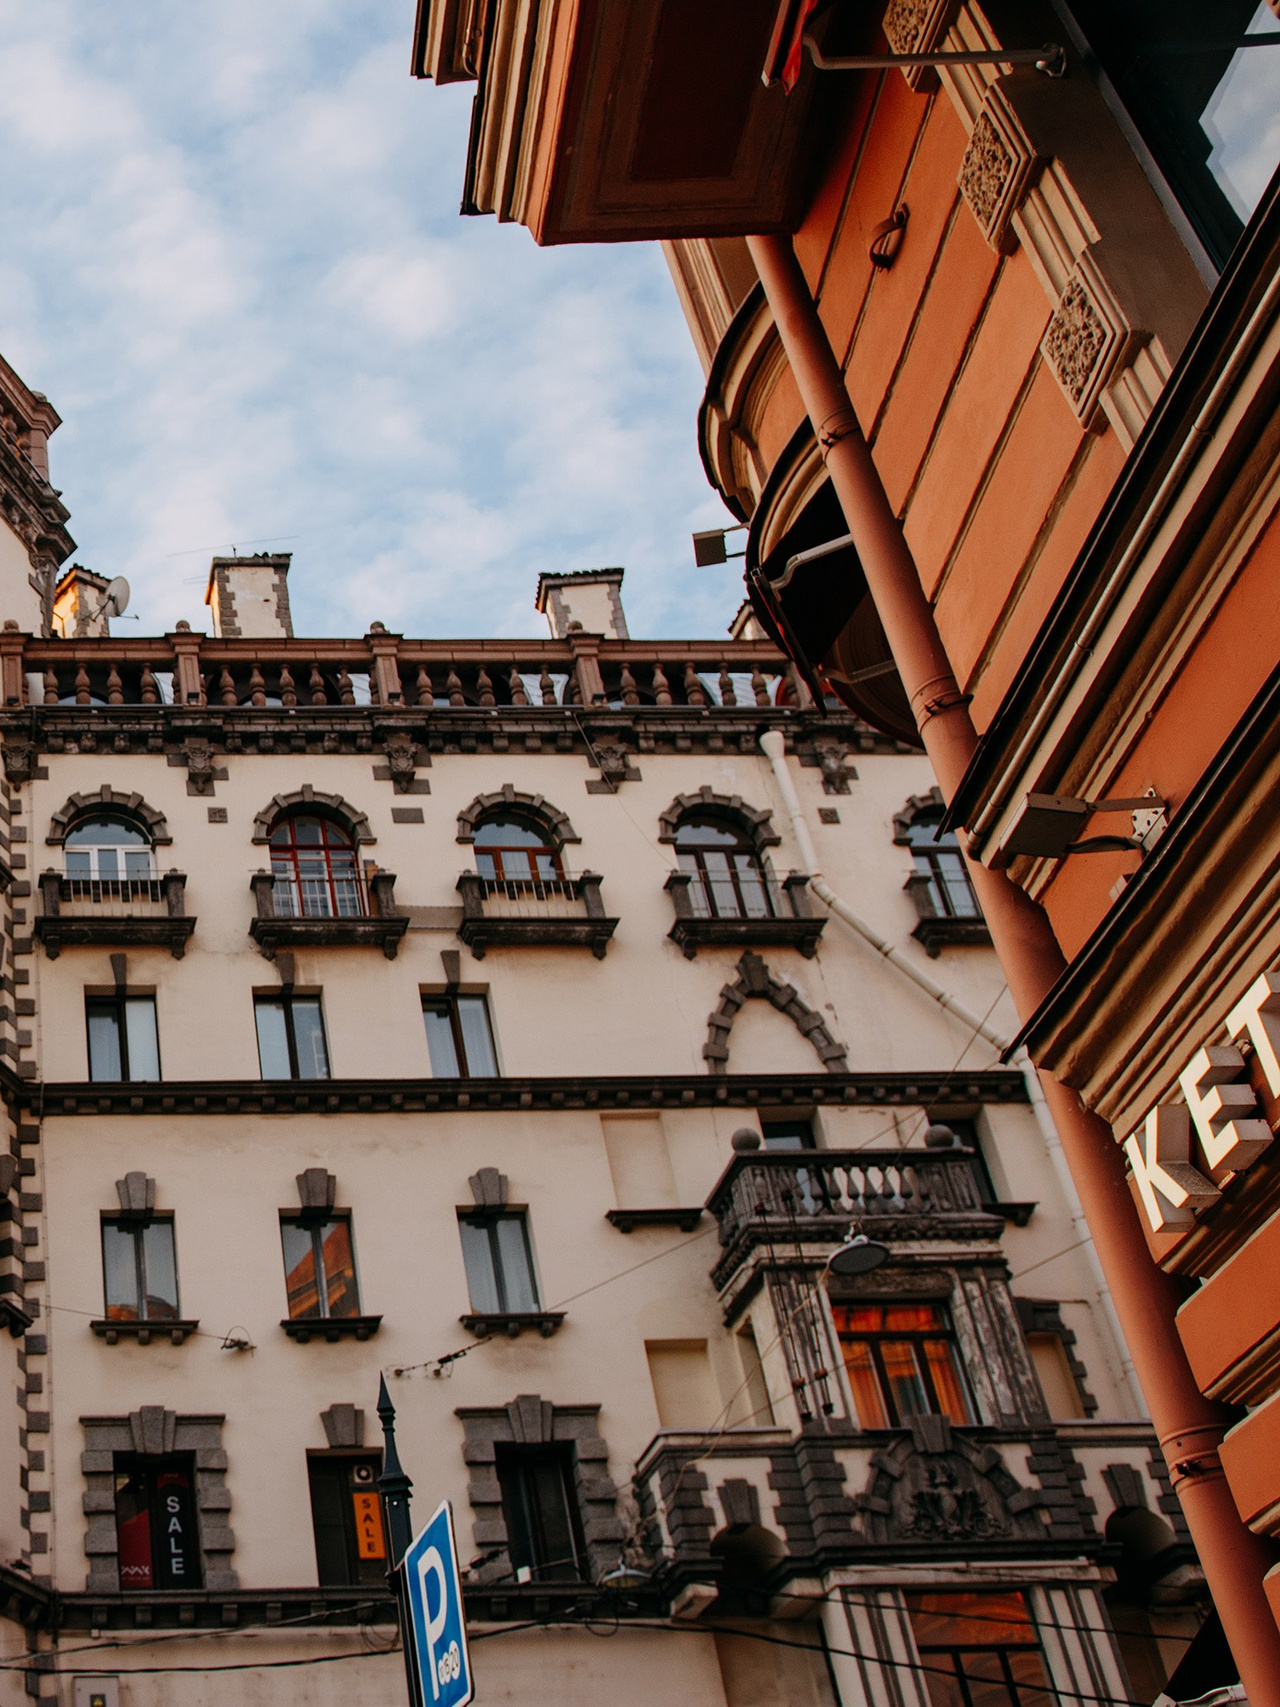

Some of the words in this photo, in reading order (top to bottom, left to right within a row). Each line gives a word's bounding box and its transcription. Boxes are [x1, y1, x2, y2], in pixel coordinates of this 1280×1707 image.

[166, 1495, 185, 1575] SALE
[361, 1498, 376, 1554] SALE
[417, 1545, 448, 1701] P
